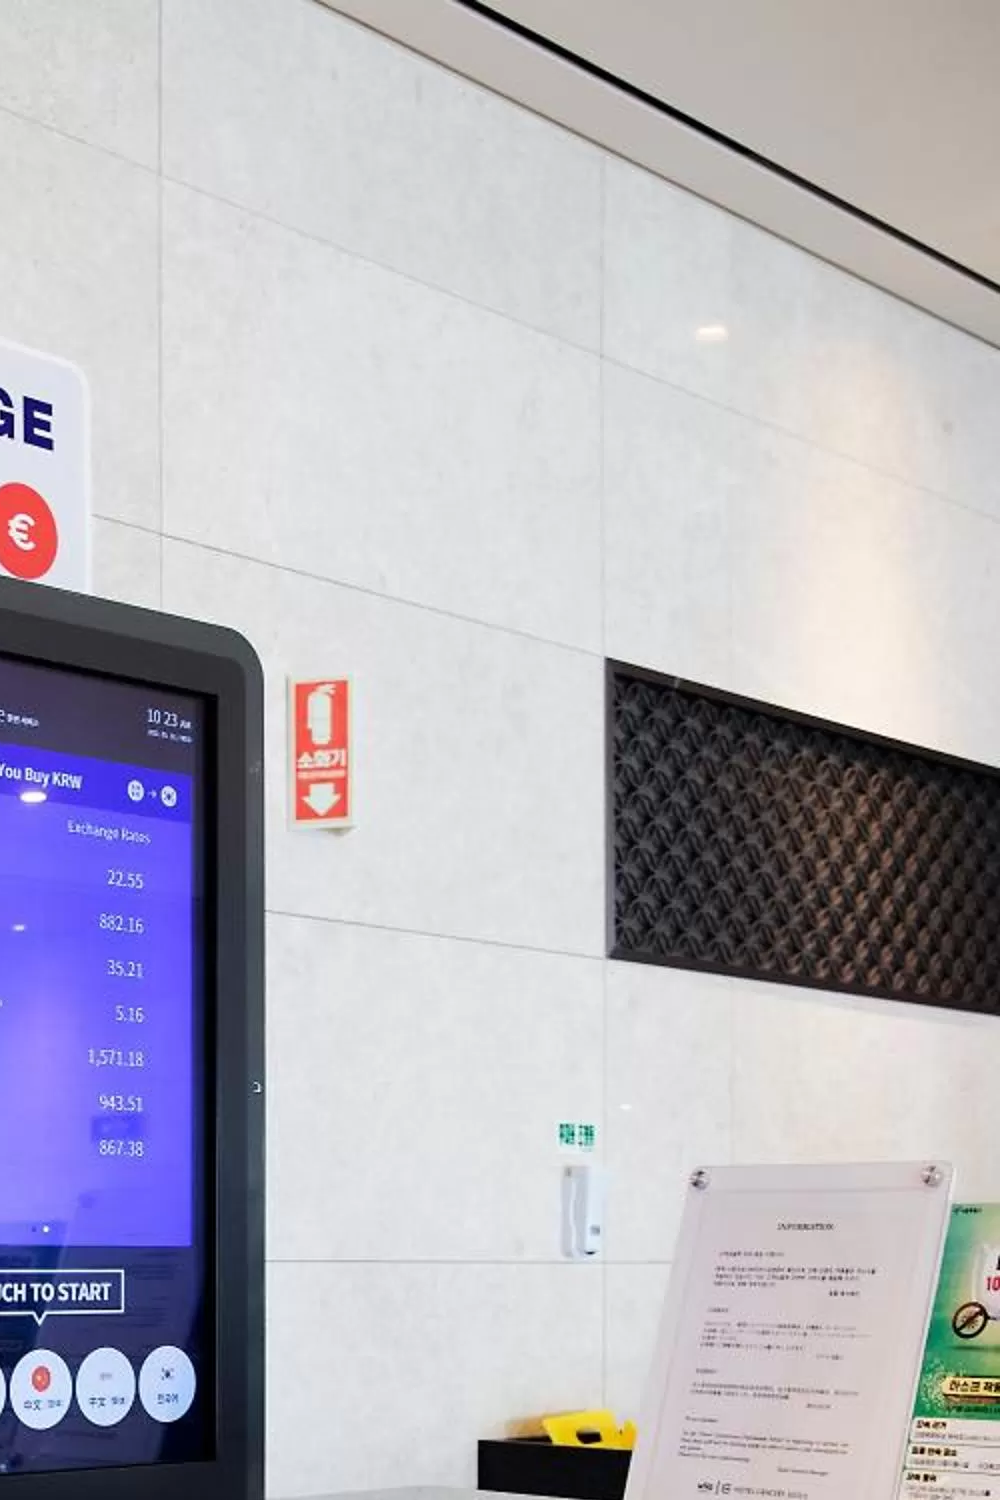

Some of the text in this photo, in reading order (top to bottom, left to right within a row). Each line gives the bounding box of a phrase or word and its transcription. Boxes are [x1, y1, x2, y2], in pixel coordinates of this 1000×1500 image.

[25, 767, 50, 787] Buy
[52, 769, 83, 791] KRW
[67, 819, 119, 842] Exchange
[107, 870, 144, 889] 22.55
[99, 912, 144, 934] 882.16
[107, 959, 144, 979] 35.21
[30, 1282, 56, 1303] TO
[57, 1281, 112, 1302] START
